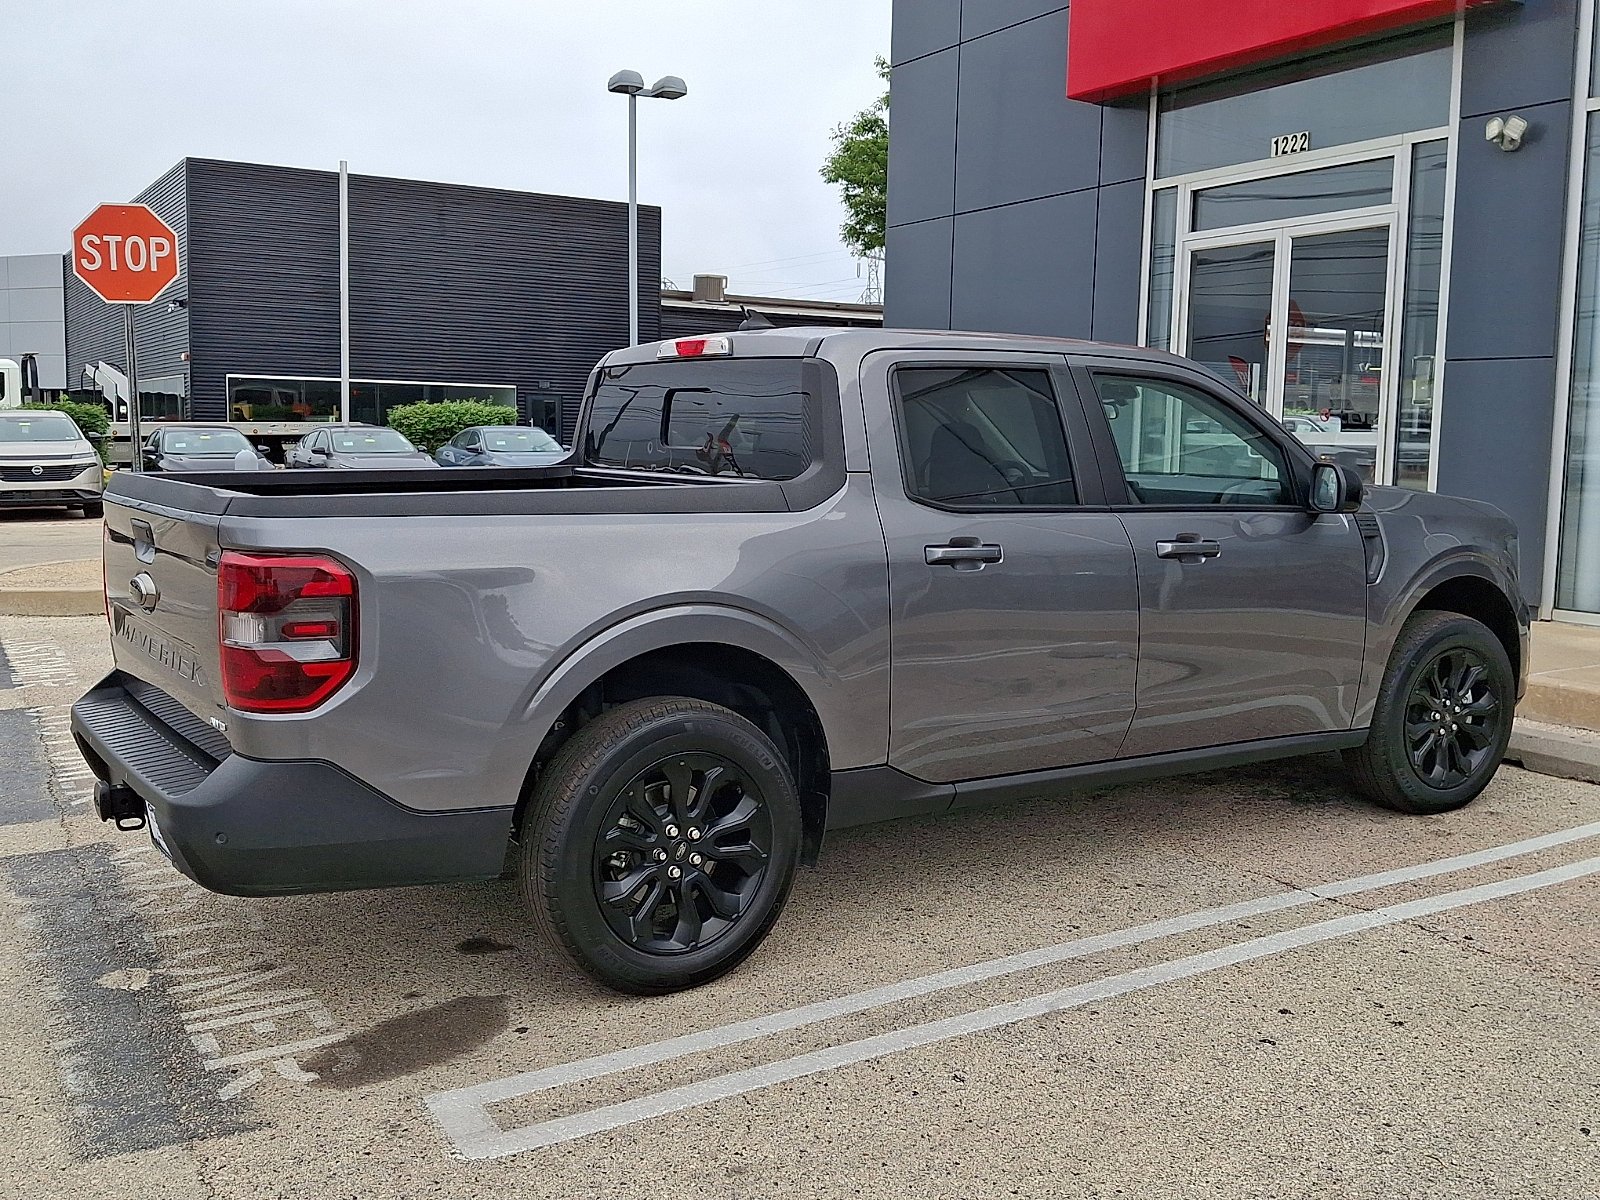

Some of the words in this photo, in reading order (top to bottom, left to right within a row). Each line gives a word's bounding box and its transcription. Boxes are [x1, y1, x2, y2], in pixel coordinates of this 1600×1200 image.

[1274, 132, 1307, 156] 1222
[80, 234, 171, 272] STOP
[122, 617, 203, 687] MAVERICK
